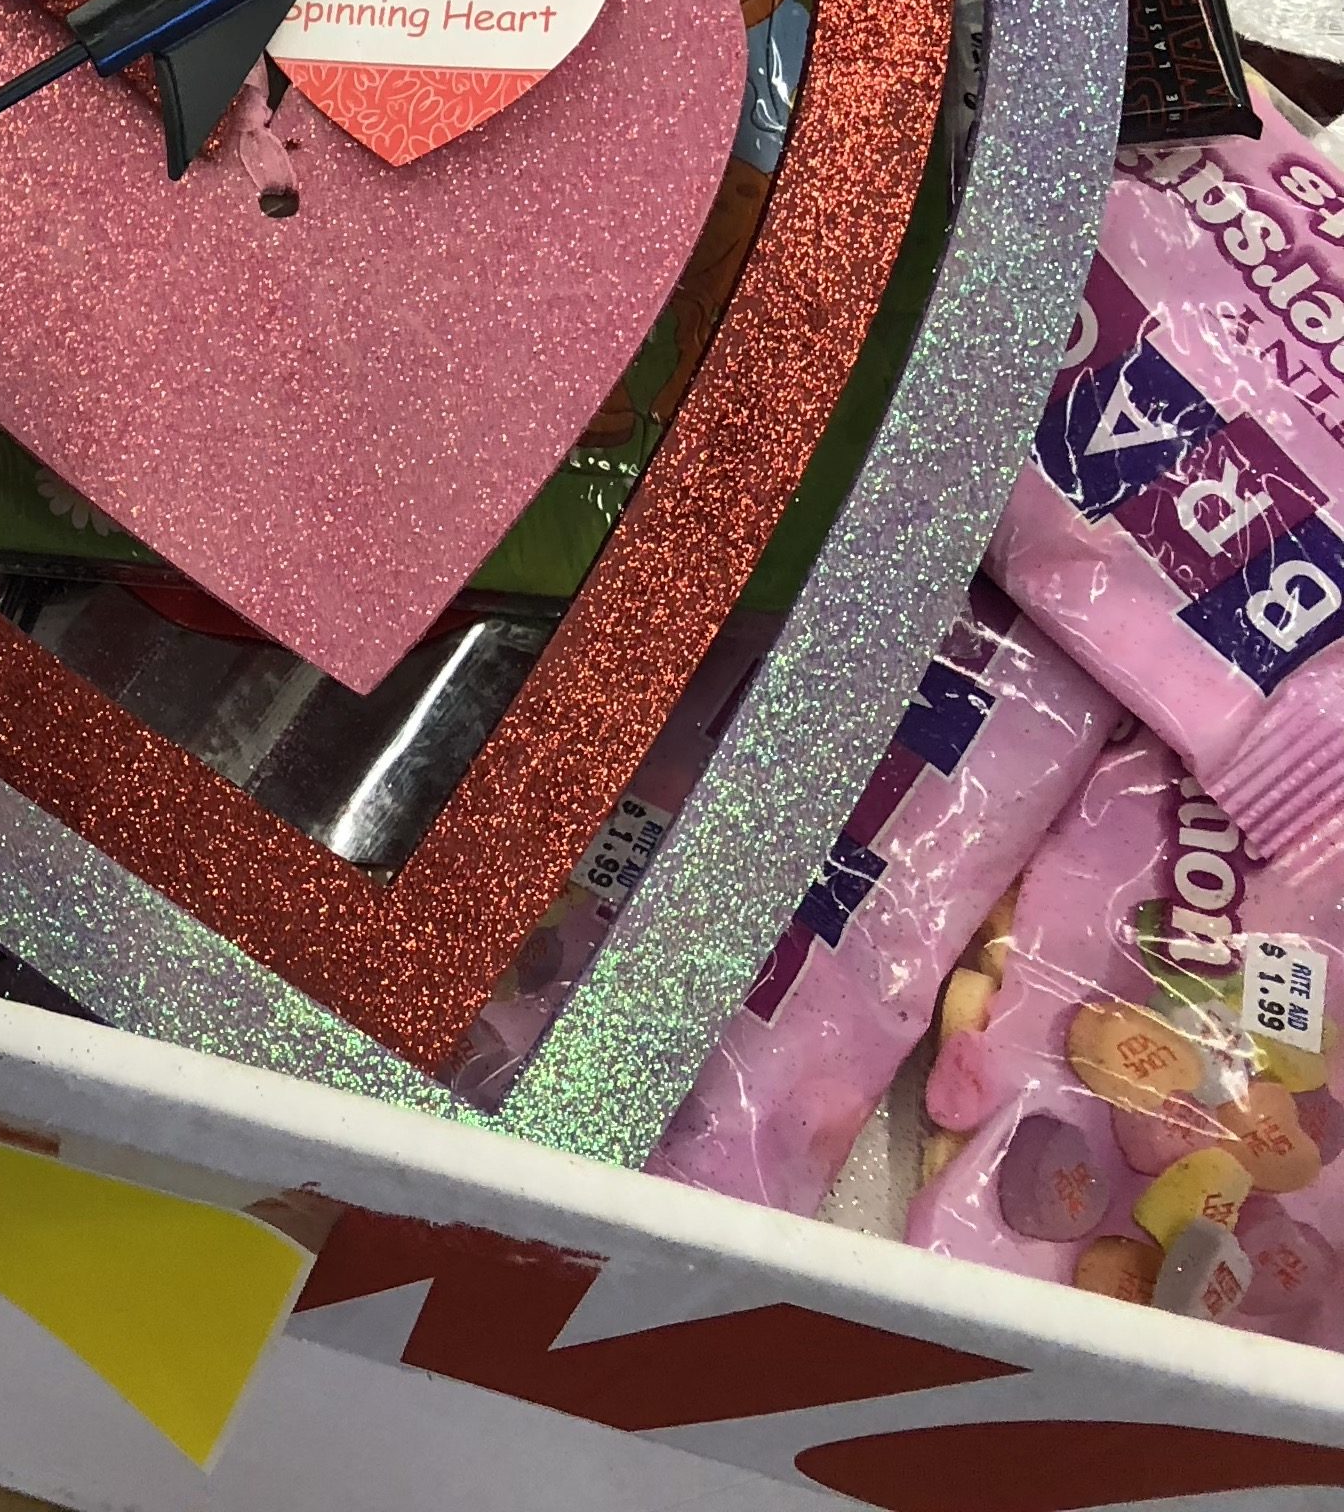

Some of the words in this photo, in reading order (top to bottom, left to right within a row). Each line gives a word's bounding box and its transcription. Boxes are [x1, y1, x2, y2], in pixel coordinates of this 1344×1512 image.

[443, 0, 557, 34] Heart
[1145, 6, 1171, 68] LAST
[633, 821, 662, 857] RITE
[588, 828, 632, 886] 1.99
[617, 858, 642, 887] AID
[1259, 942, 1286, 958] $
[1289, 963, 1312, 998] RITE
[1257, 971, 1286, 1032] 1.99
[1286, 1003, 1309, 1032] AID
